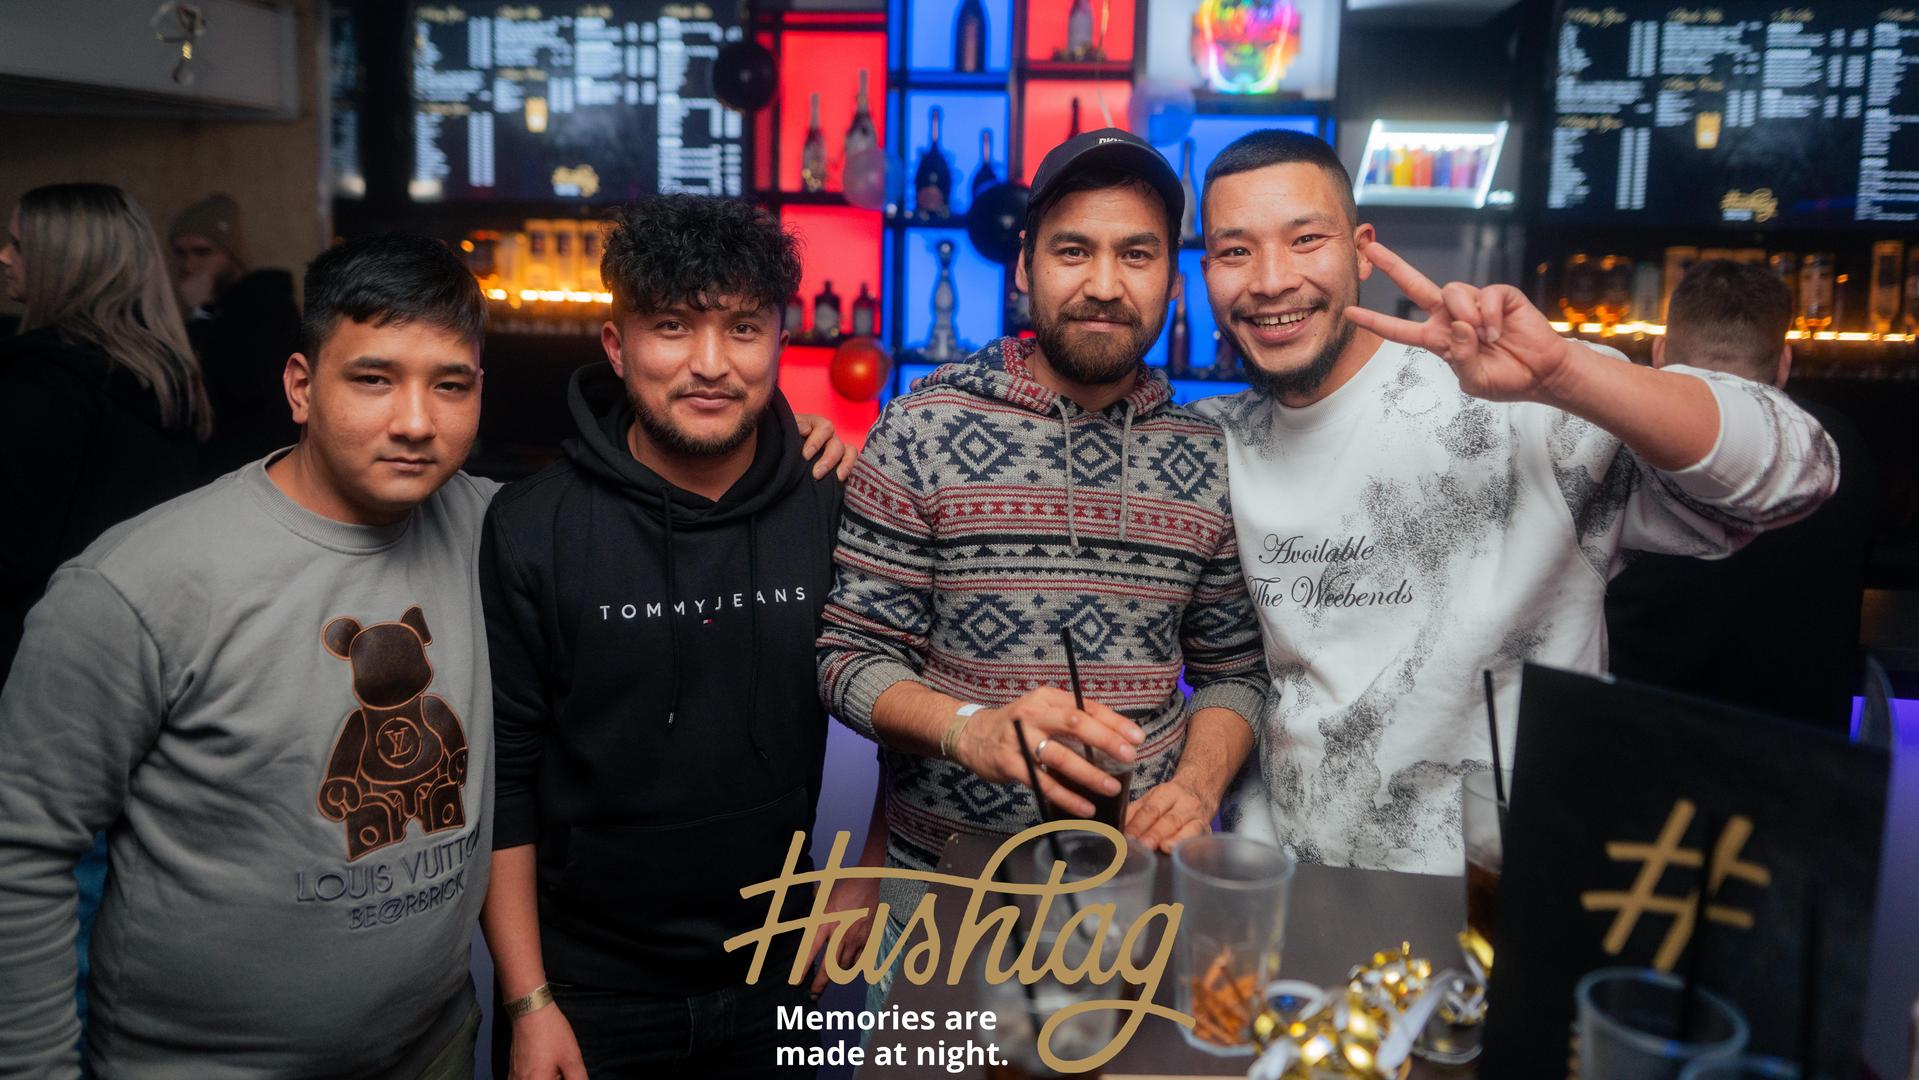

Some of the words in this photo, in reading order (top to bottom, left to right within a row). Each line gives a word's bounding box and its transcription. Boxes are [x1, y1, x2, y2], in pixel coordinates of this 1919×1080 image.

[600, 599, 705, 620] TOMMY
[715, 586, 806, 611] JEANS
[1248, 575, 1284, 607] The
[296, 864, 394, 902] LOUIS
[349, 868, 465, 930] BE@RBRICK
